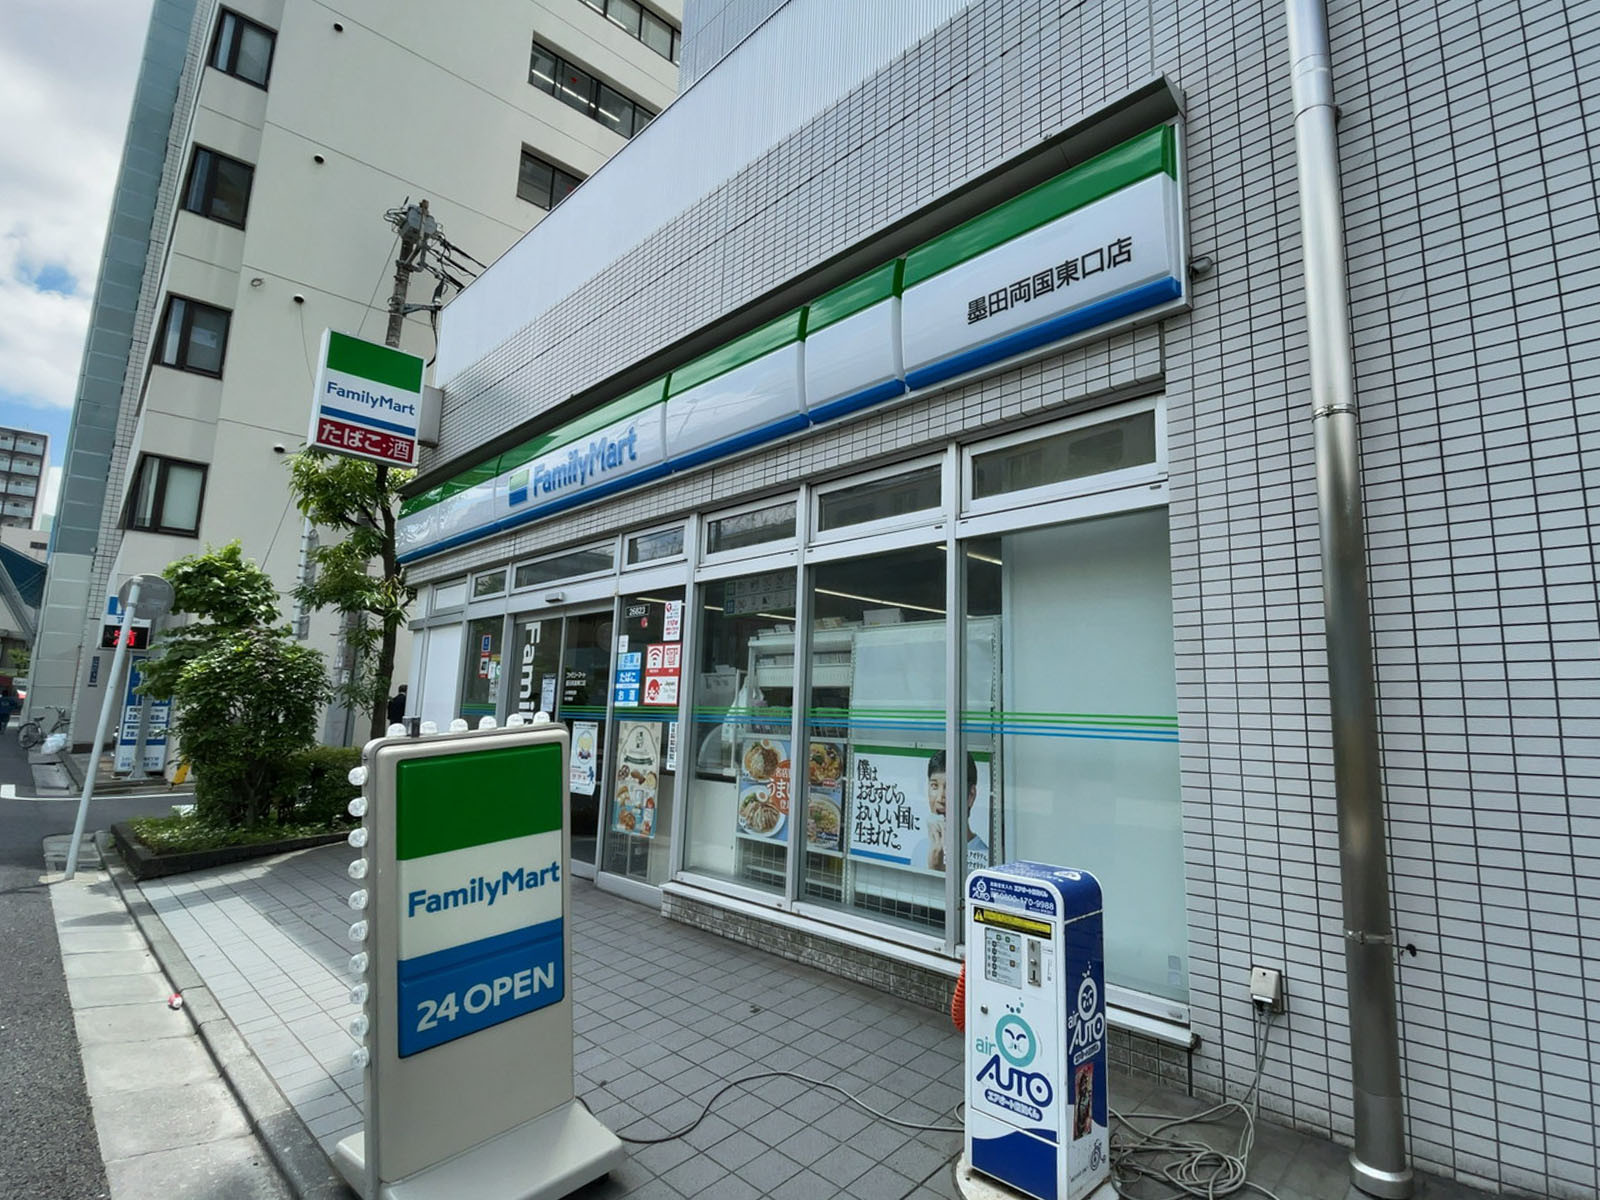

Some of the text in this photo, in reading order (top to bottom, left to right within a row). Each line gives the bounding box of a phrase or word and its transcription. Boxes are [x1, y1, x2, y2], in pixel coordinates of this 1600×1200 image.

[968, 236, 1132, 325] 墨田両国東口店
[327, 381, 415, 416] FamilyMart
[533, 427, 637, 497] FamilyMart
[519, 621, 541, 725] Famil
[857, 759, 878, 781] 僕は
[856, 782, 905, 806] おむすびの
[855, 802, 920, 831] おいしい国に
[408, 861, 560, 918] FamilyMart
[416, 961, 555, 1032] 24 OPEN
[1068, 1010, 1081, 1029] air
[1069, 1012, 1105, 1055] AUTO
[976, 1036, 996, 1056] air
[976, 1053, 1053, 1108] AUTO
